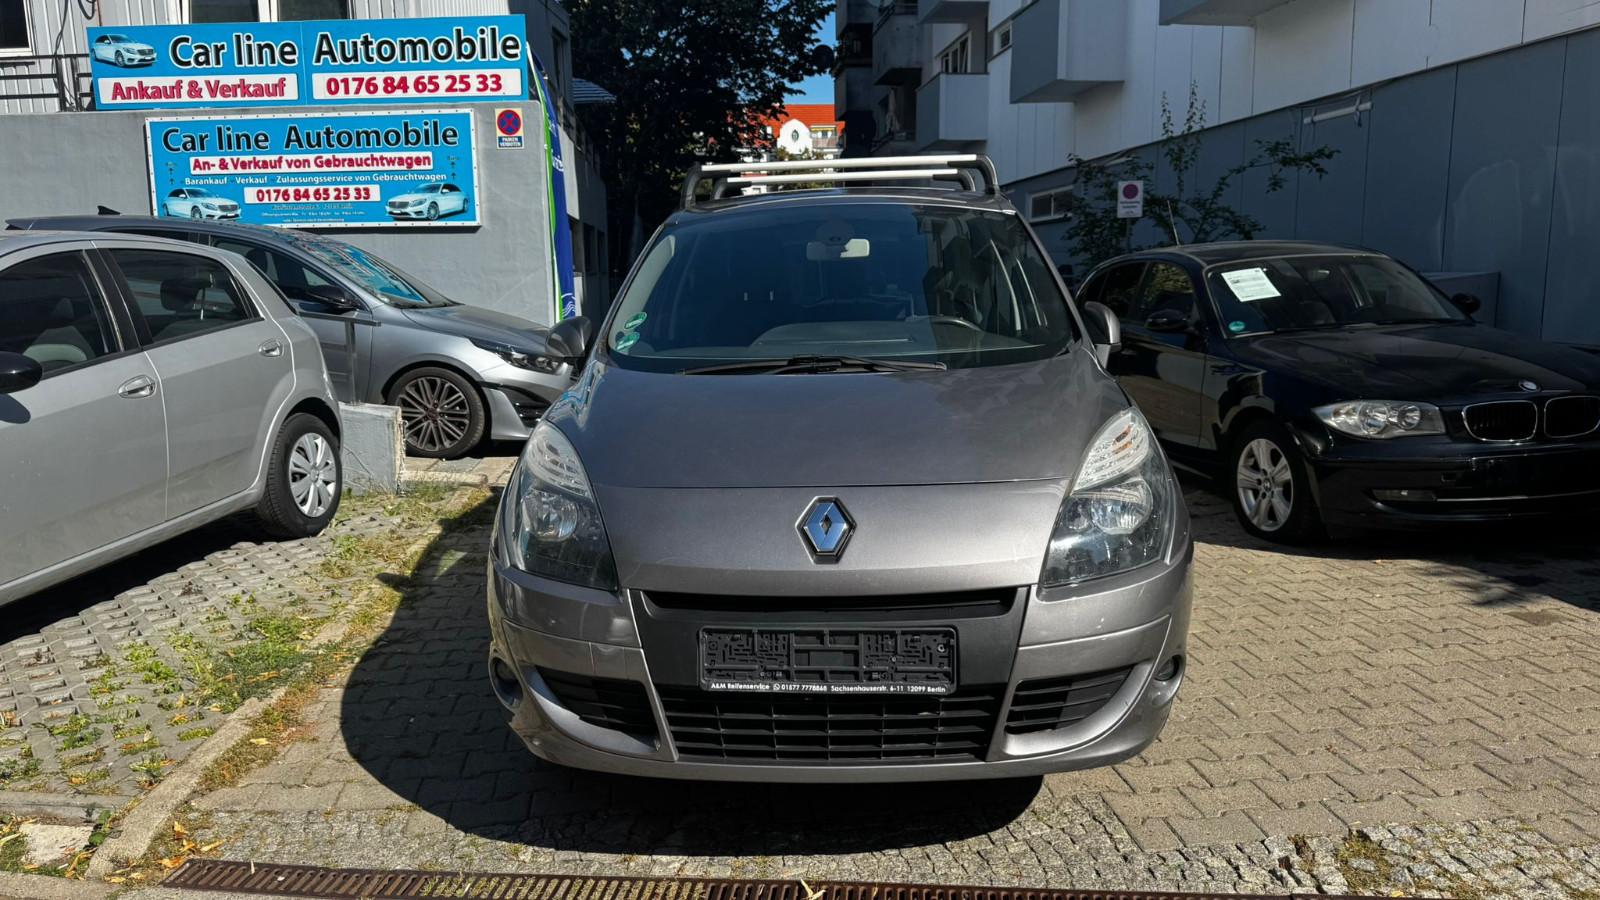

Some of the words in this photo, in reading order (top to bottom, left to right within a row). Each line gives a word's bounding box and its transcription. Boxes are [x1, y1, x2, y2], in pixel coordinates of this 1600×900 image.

[169, 35, 227, 69] Car
[233, 32, 299, 67] line
[312, 26, 521, 66] Automobile
[112, 80, 183, 101] Ankauf
[187, 80, 203, 99] &
[205, 77, 286, 99] Verkauf
[326, 77, 378, 96] 0176
[382, 76, 409, 94] 84
[413, 75, 440, 93] 65
[444, 74, 471, 92] 25
[476, 73, 503, 92] 33
[162, 127, 209, 153] Car
[216, 124, 270, 151] line
[284, 119, 459, 150] Automobile
[192, 159, 216, 171] An-
[218, 158, 229, 170] &
[230, 156, 284, 170] Verkauf
[285, 159, 311, 169] von
[314, 154, 432, 169] Gebrauchtwagen
[185, 176, 228, 185] Barankauf
[276, 175, 352, 184] Zulassungsservice
[372, 173, 447, 182] Gebrauchtwagen
[256, 189, 290, 202] 0176
[293, 188, 310, 201] 84
[313, 188, 330, 201] 65
[333, 187, 350, 200] 25
[354, 187, 371, 200] 33
